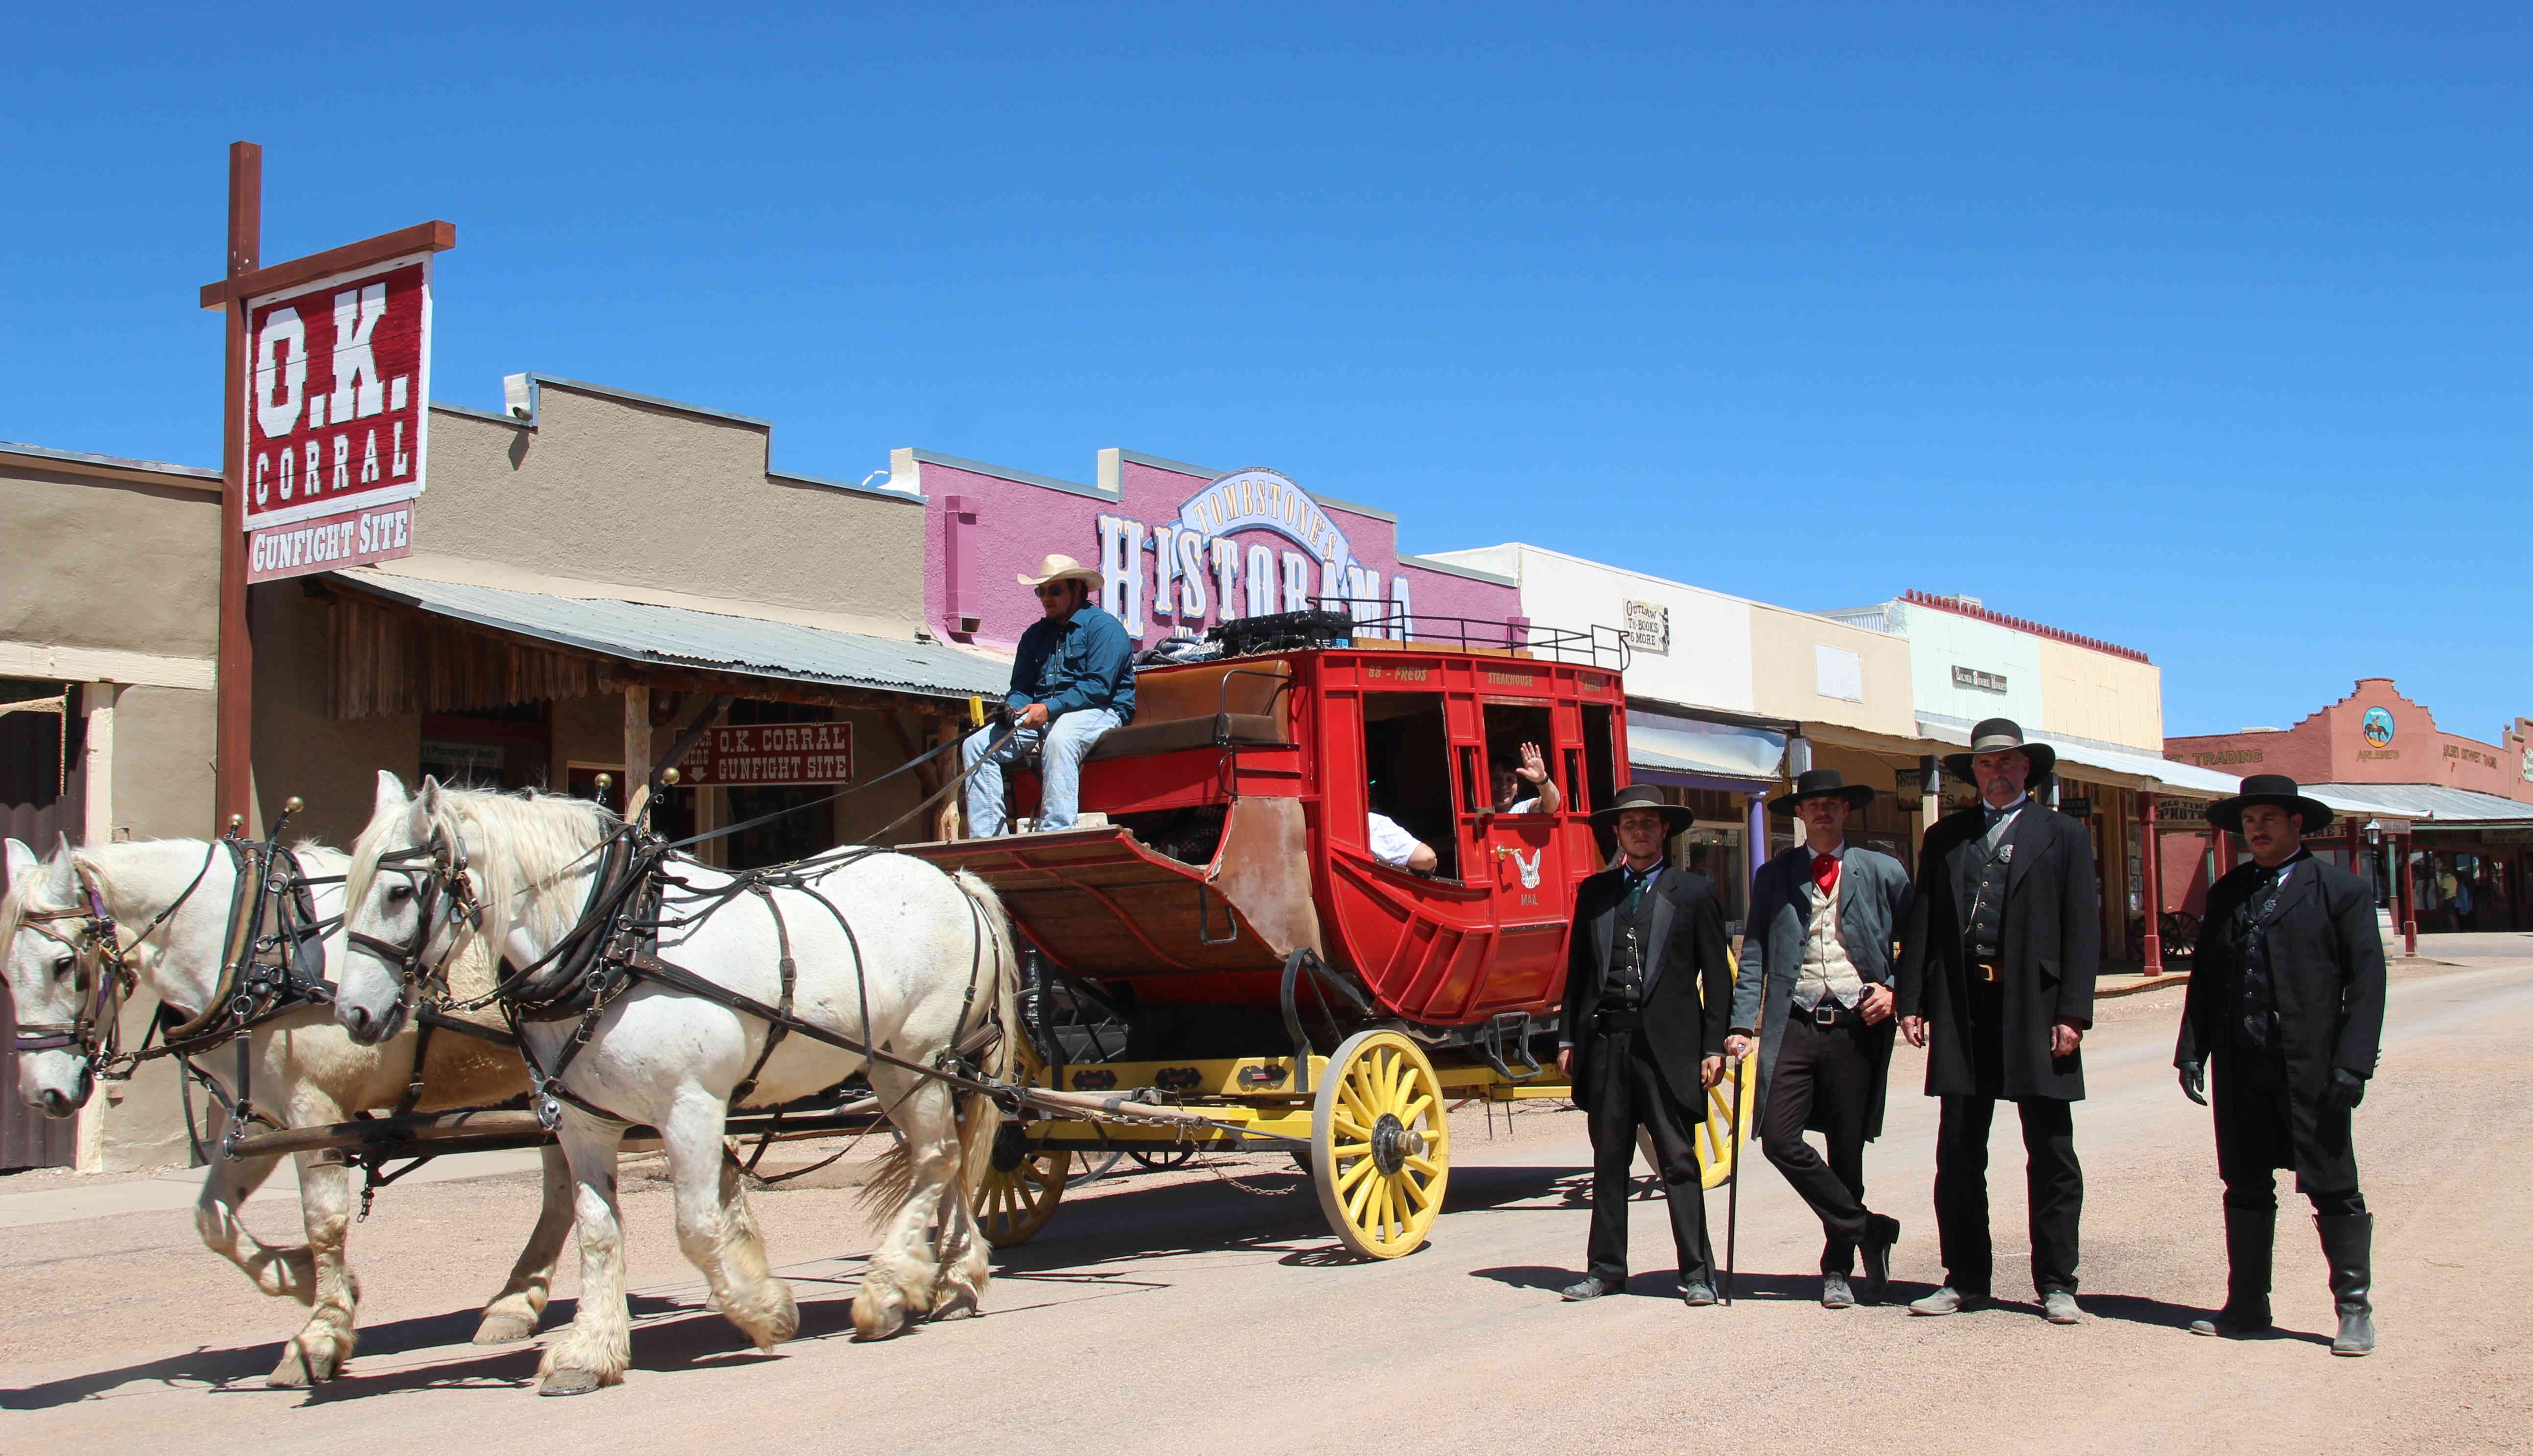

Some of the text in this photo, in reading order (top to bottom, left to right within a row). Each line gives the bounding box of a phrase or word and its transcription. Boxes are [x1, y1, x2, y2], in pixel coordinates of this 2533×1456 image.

[256, 281, 409, 439] O.K.
[256, 421, 407, 506] CORRAL
[1193, 480, 1337, 560] TOMBSTONE'S
[252, 509, 408, 573] GUNFIGHT SITE
[1627, 601, 1656, 619] OUTLAW
[1638, 620, 1658, 633] BOOKS
[1630, 632, 1655, 645] & MORE
[1488, 672, 1533, 687] STEAKHOUSE
[720, 730, 756, 752] O.K.
[763, 727, 846, 751] CORRAL
[718, 755, 846, 780] GUNFIGHT SITE
[2192, 749, 2263, 765] TRADING
[1521, 894, 1538, 906] MAIL
